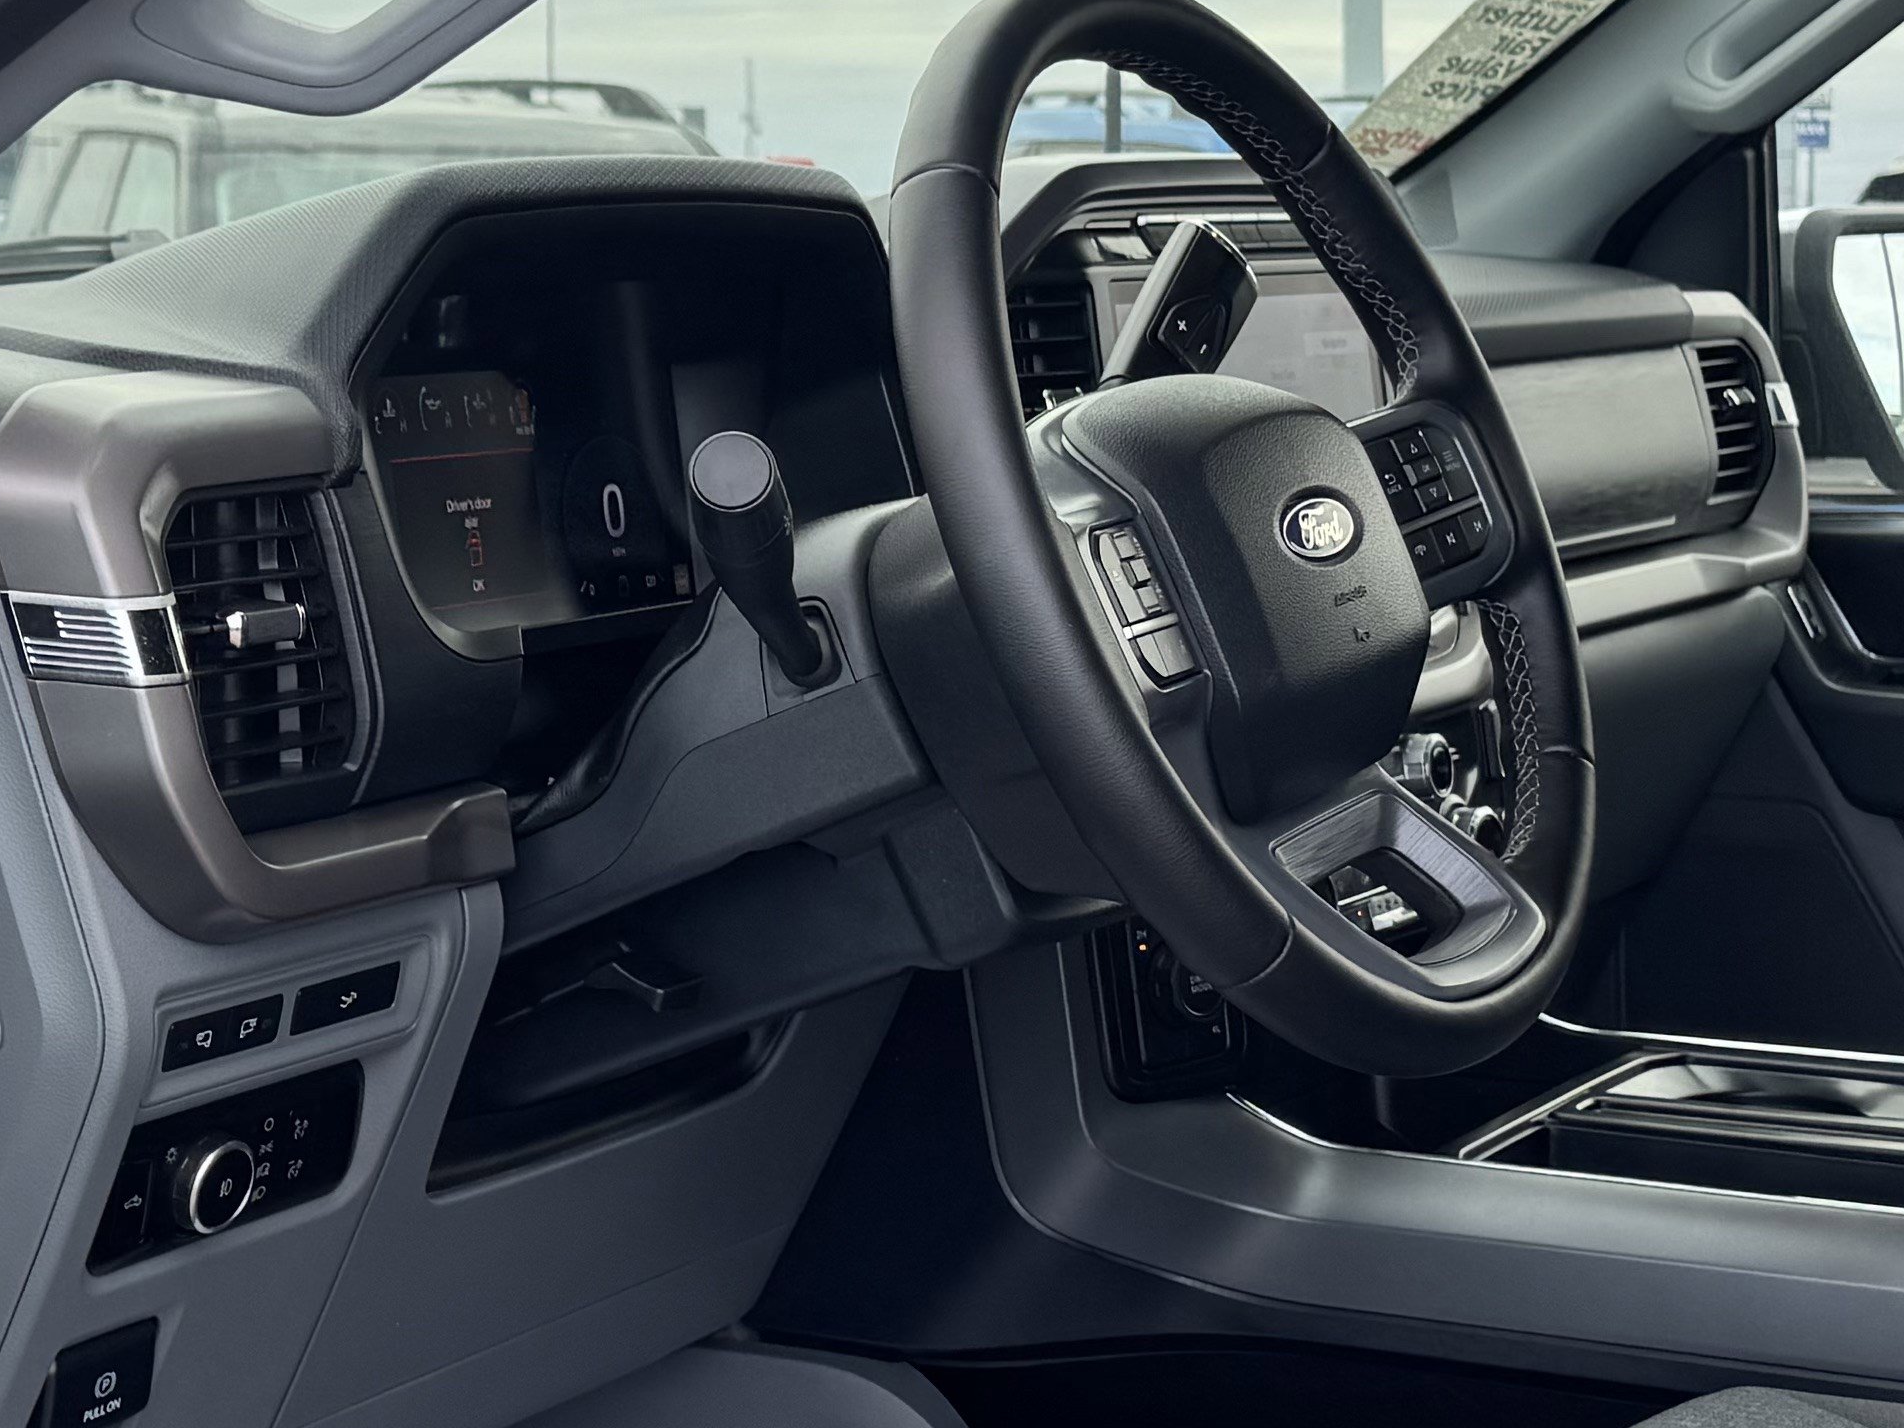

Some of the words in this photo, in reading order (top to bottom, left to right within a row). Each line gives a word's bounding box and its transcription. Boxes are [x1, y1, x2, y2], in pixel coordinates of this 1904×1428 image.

[445, 498, 475, 514] Driver's
[603, 483, 626, 538] 0
[1298, 503, 1344, 550] Ford
[82, 1404, 106, 1423] PULL
[106, 1397, 122, 1413] ON
